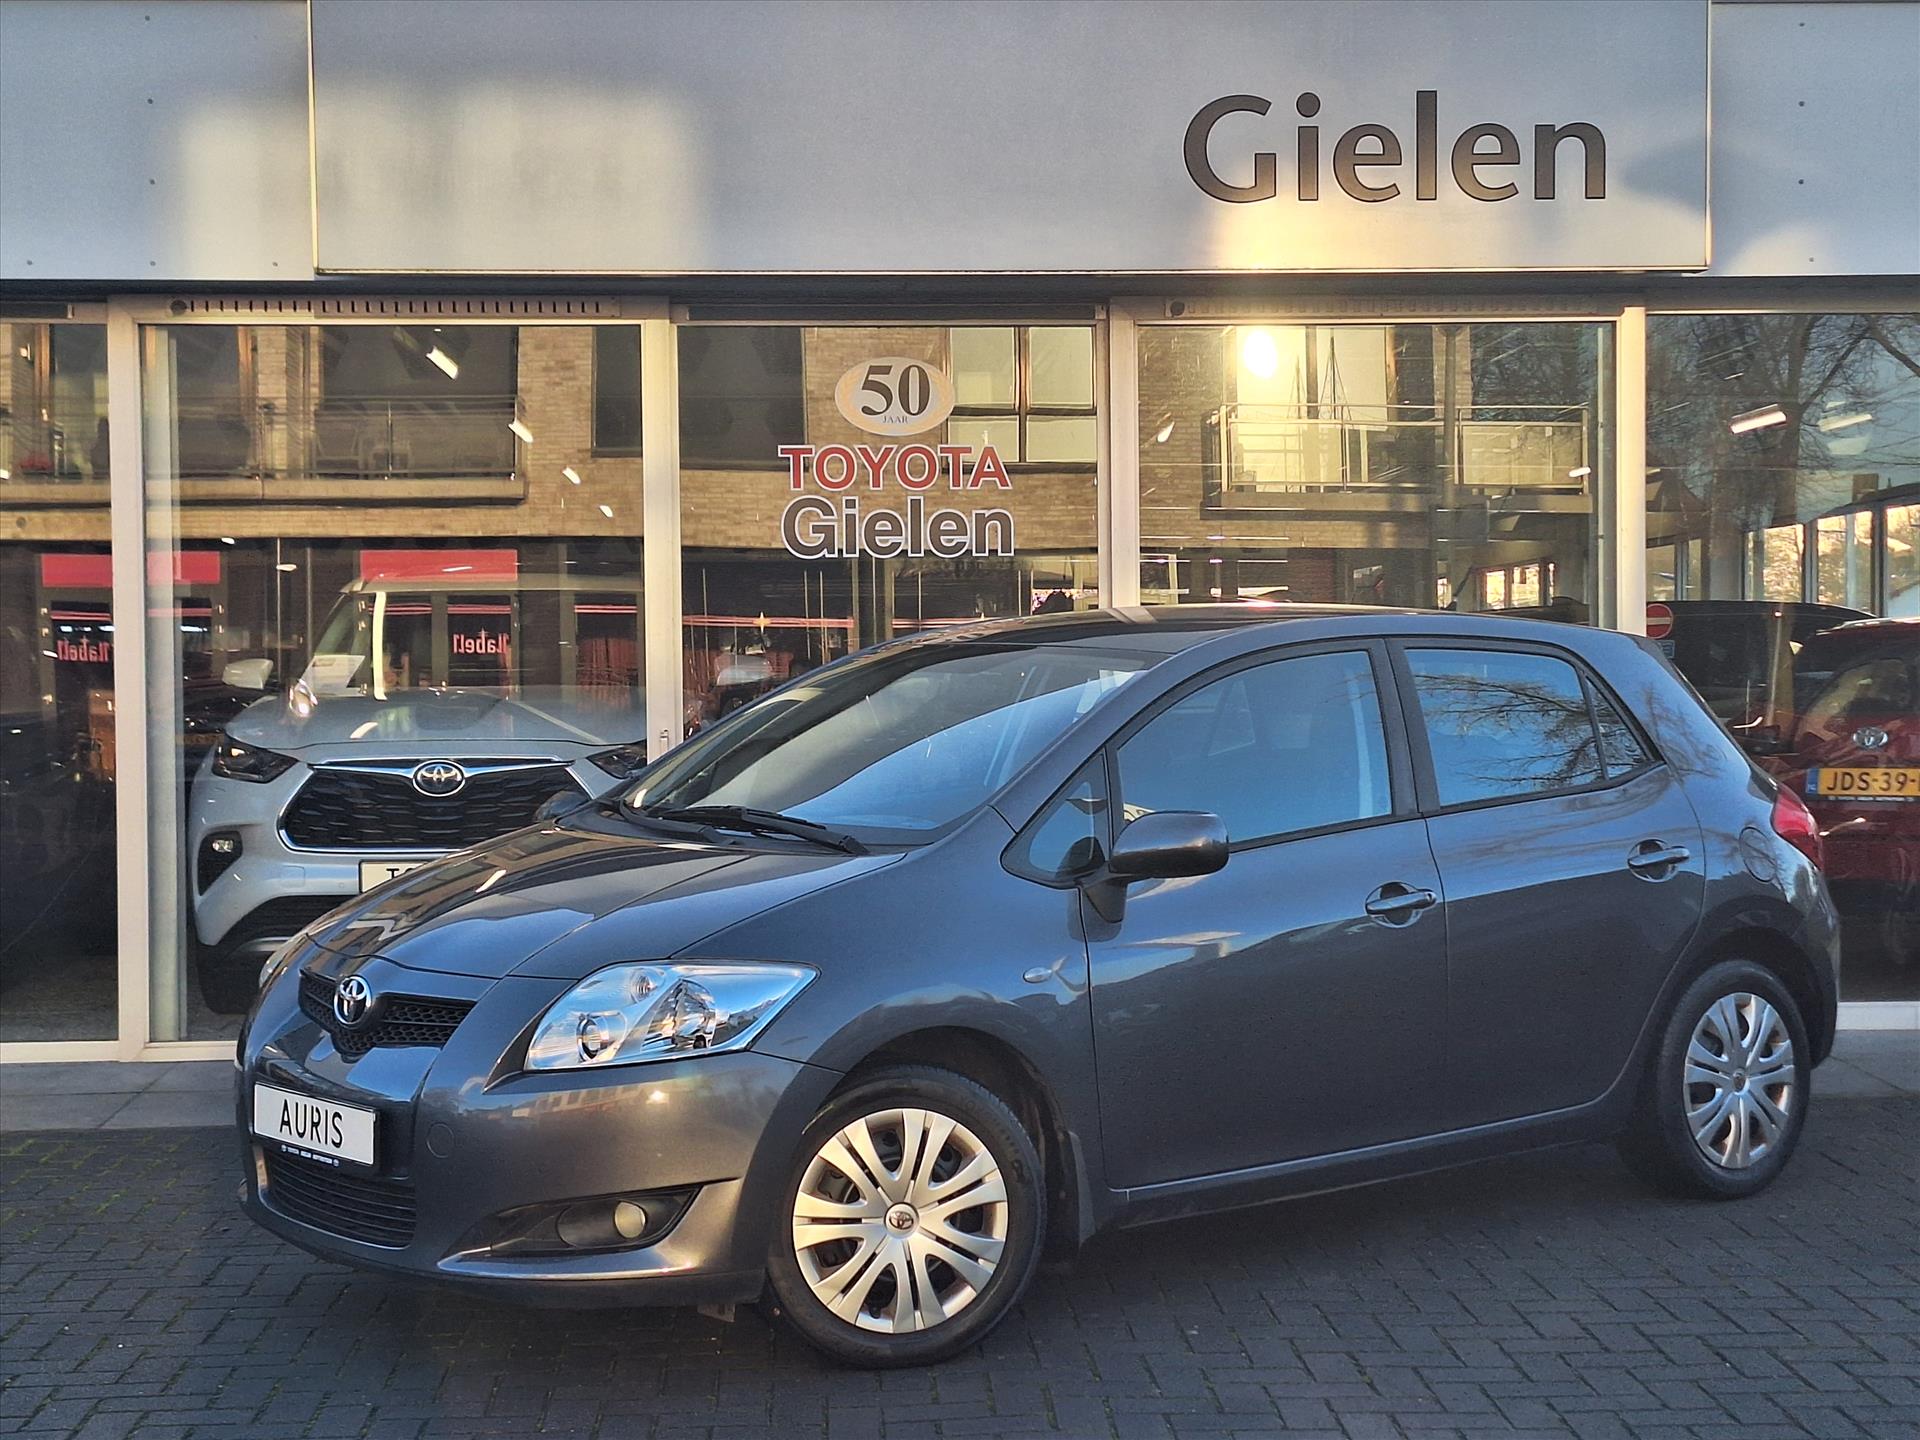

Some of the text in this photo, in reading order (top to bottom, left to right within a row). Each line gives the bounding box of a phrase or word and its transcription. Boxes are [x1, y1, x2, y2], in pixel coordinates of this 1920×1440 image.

[1184, 90, 1607, 203] Gielen
[860, 364, 931, 416] 50
[882, 415, 909, 425] JAAR
[779, 445, 1011, 490] TOYOTA
[781, 495, 1015, 559] Gielen
[1826, 771, 1920, 792] JDS-39-
[280, 1098, 343, 1149] AURIS
